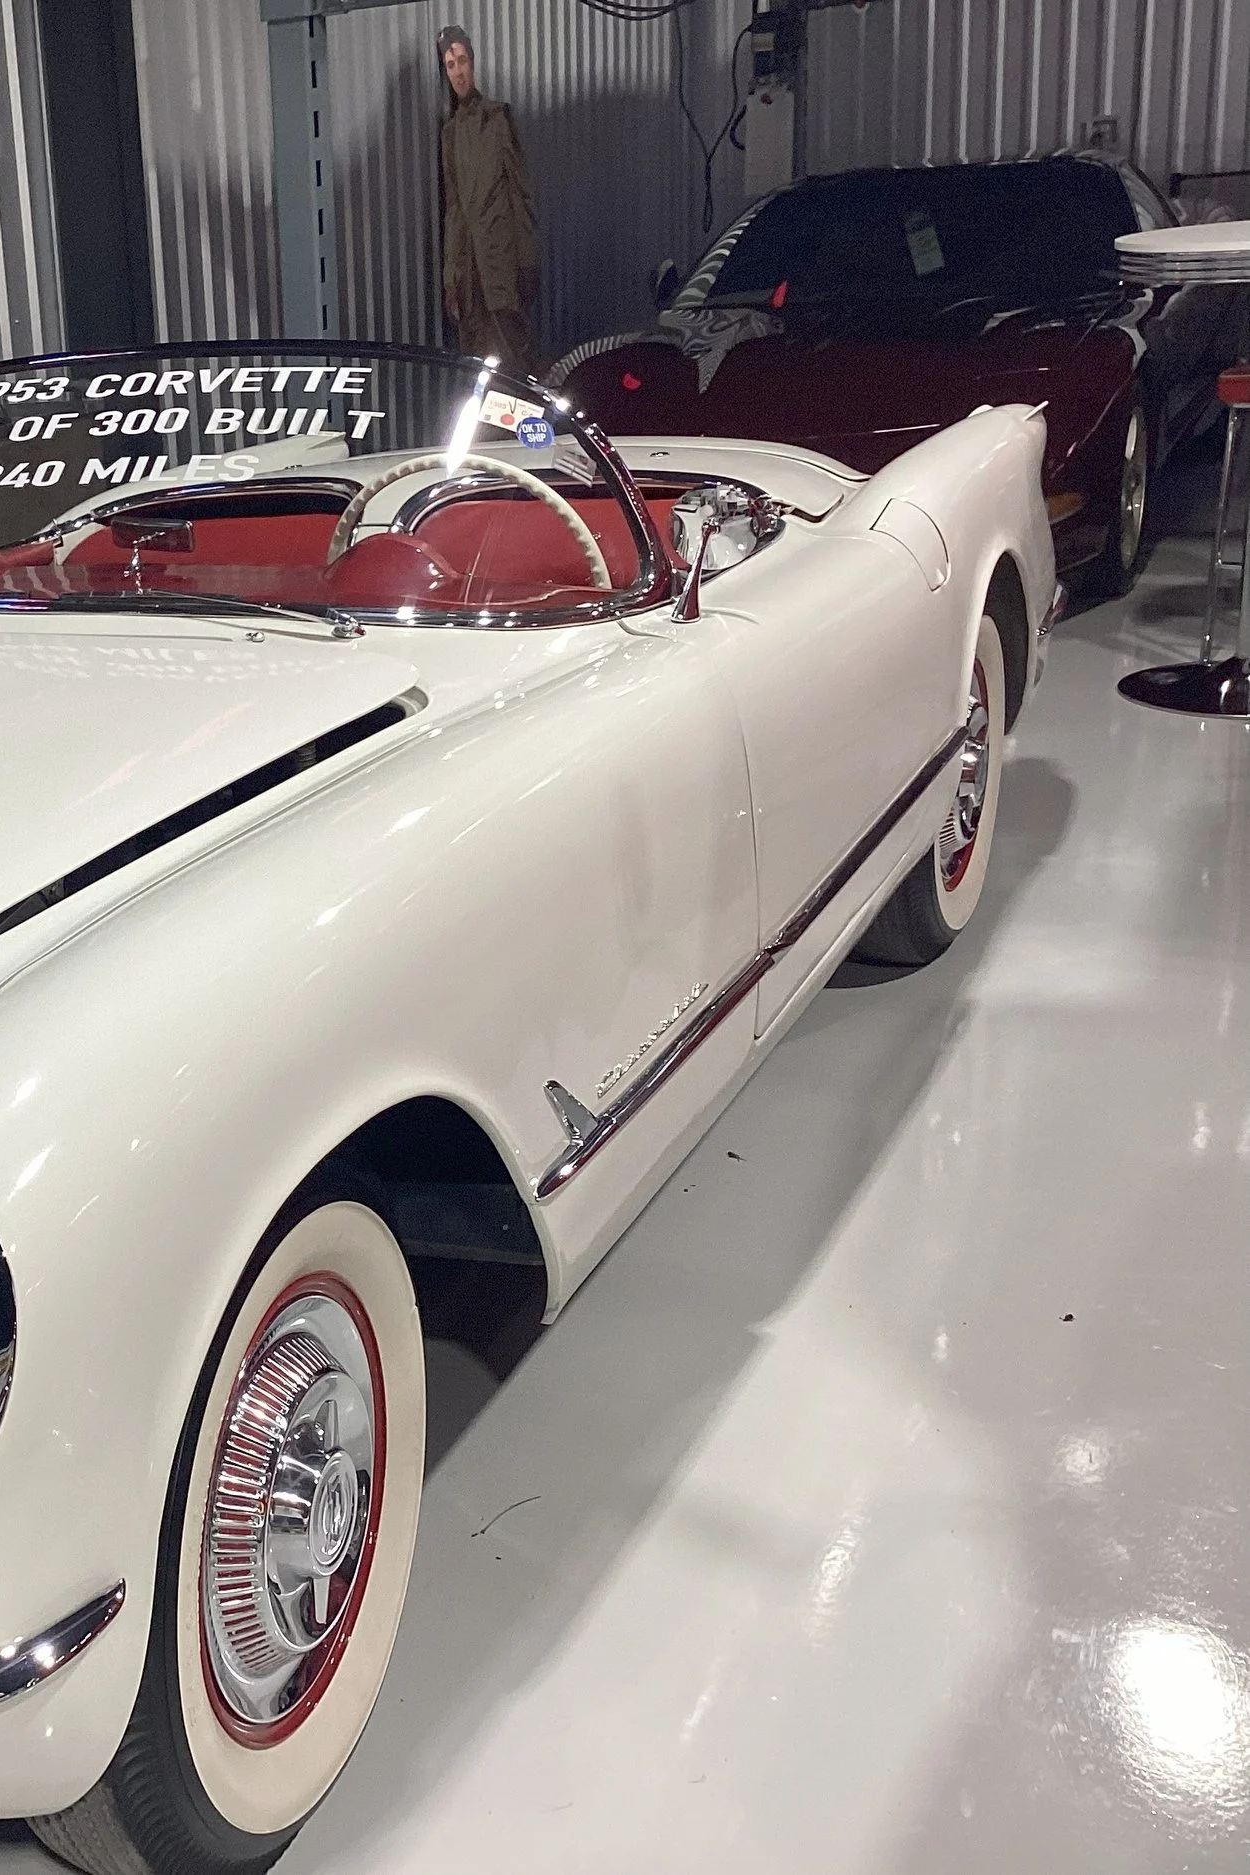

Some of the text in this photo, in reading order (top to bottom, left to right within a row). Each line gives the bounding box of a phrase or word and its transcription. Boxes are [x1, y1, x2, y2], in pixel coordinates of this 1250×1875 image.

[84, 366, 372, 398] CORVETTE
[8, 412, 80, 443] OF
[88, 407, 196, 439] 300
[203, 406, 386, 440] BUILT
[522, 424, 547, 433] OK TO
[526, 434, 546, 443] SHIP
[77, 454, 261, 486] MILES
